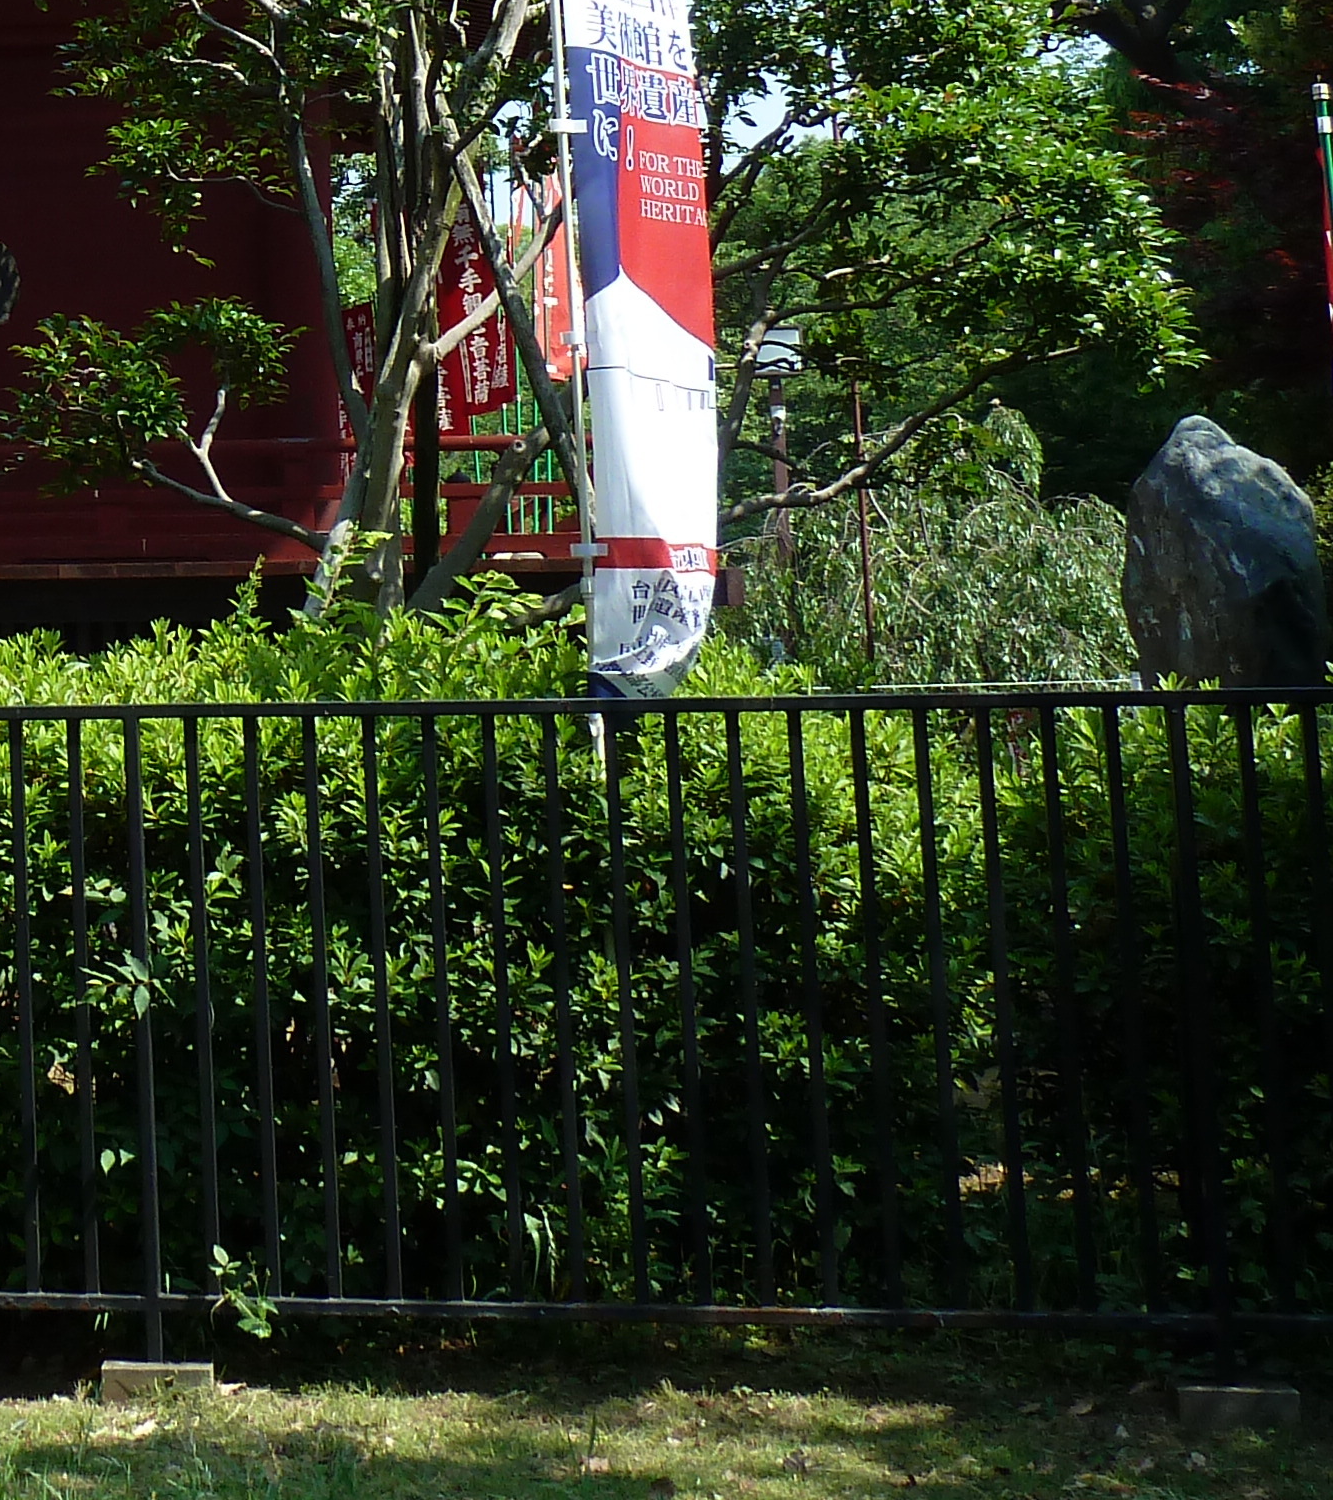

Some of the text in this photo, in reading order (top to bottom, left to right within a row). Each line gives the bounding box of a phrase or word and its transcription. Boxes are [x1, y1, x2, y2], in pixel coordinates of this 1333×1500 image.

[586, 0, 689, 71] 美術館を
[586, 52, 700, 127] 世界遺産
[639, 150, 703, 179] FOR THE
[639, 174, 700, 201] WORLD
